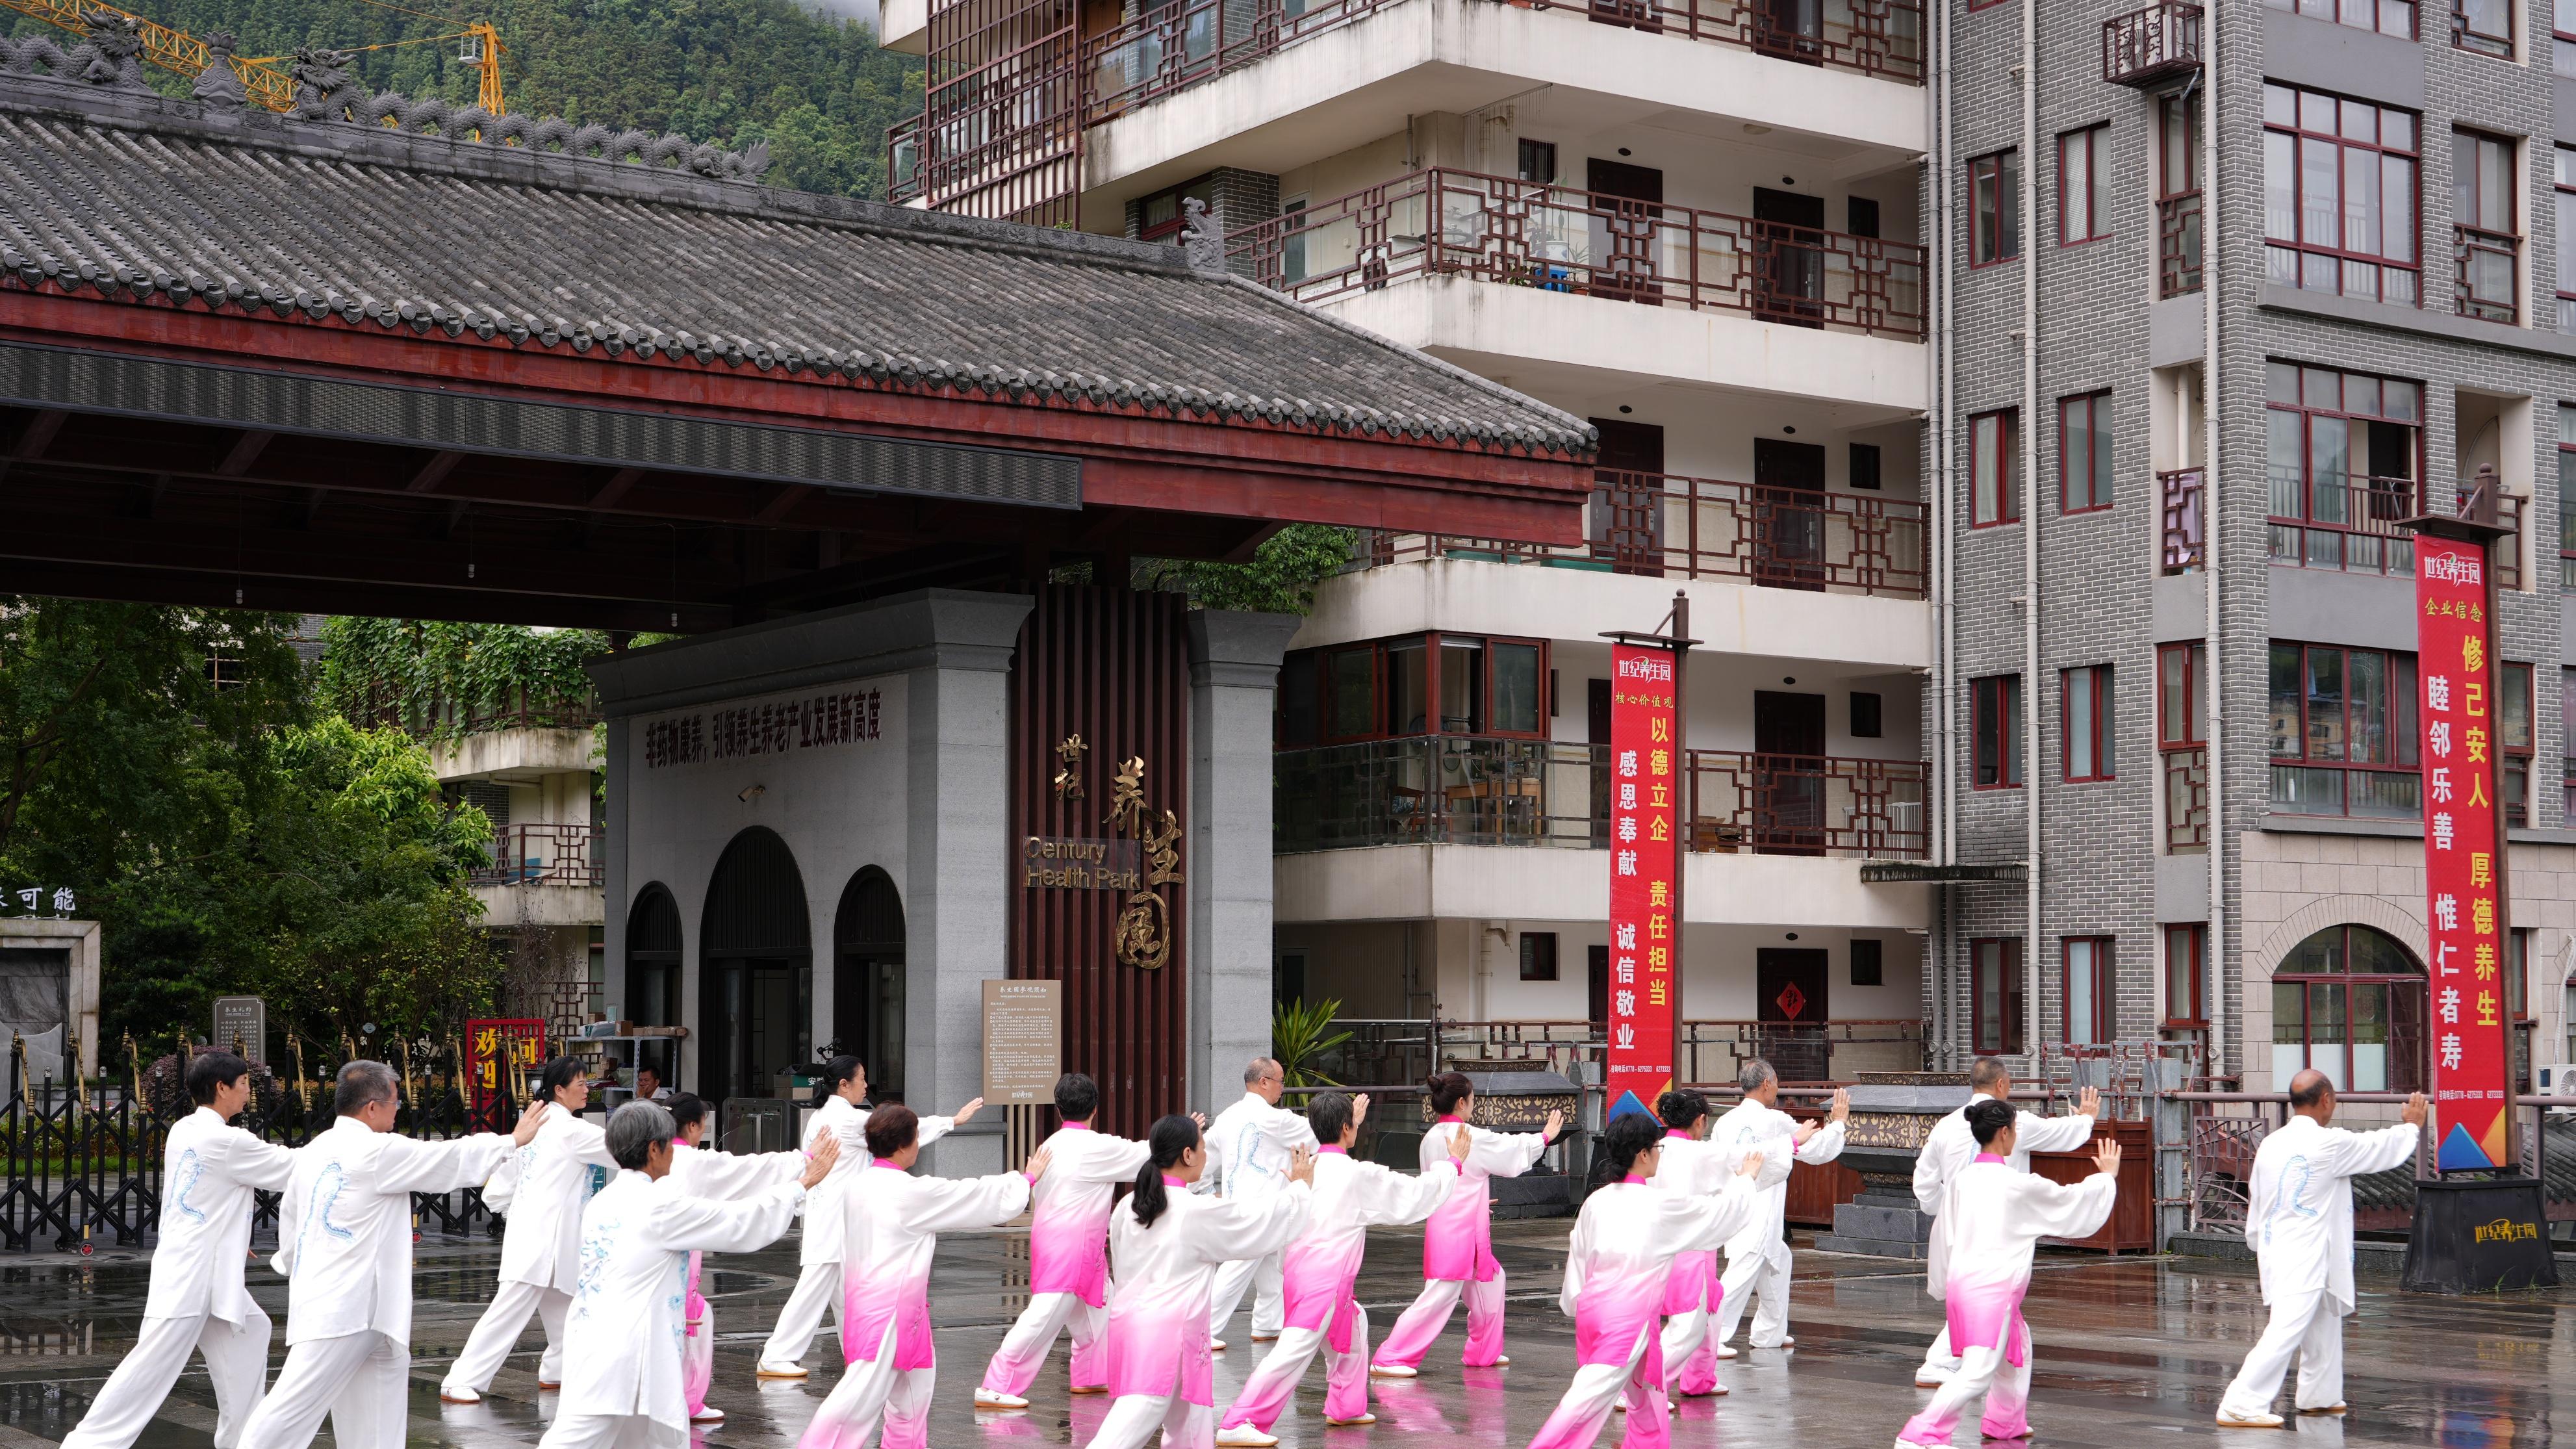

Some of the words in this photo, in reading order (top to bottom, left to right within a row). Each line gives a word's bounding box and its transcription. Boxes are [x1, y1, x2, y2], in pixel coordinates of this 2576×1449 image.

[2424, 556, 2480, 587] 世纪养生园
[2425, 597, 2483, 622] 企业信念
[1615, 691, 1674, 708] 核心价值观
[1619, 660, 1671, 684] 世纪养生园
[2462, 635, 2488, 808] 修己安人
[1618, 750, 1637, 877] 感恩奉献
[1650, 717, 1668, 841] 以德立企
[2427, 675, 2454, 850] 睦邻乐善
[1024, 837, 1106, 865] Century
[1025, 865, 1090, 888] Health
[1095, 867, 1141, 890] Park
[1103, 756, 1185, 969] 养生园
[1616, 923, 1636, 1049] 诚信敬业
[1648, 880, 1667, 1006] 责任担当
[2435, 893, 2462, 1071] 惟仁者寿
[2470, 853, 2497, 1026] 厚德养生
[2475, 1221, 2538, 1244] 世纪养生园
